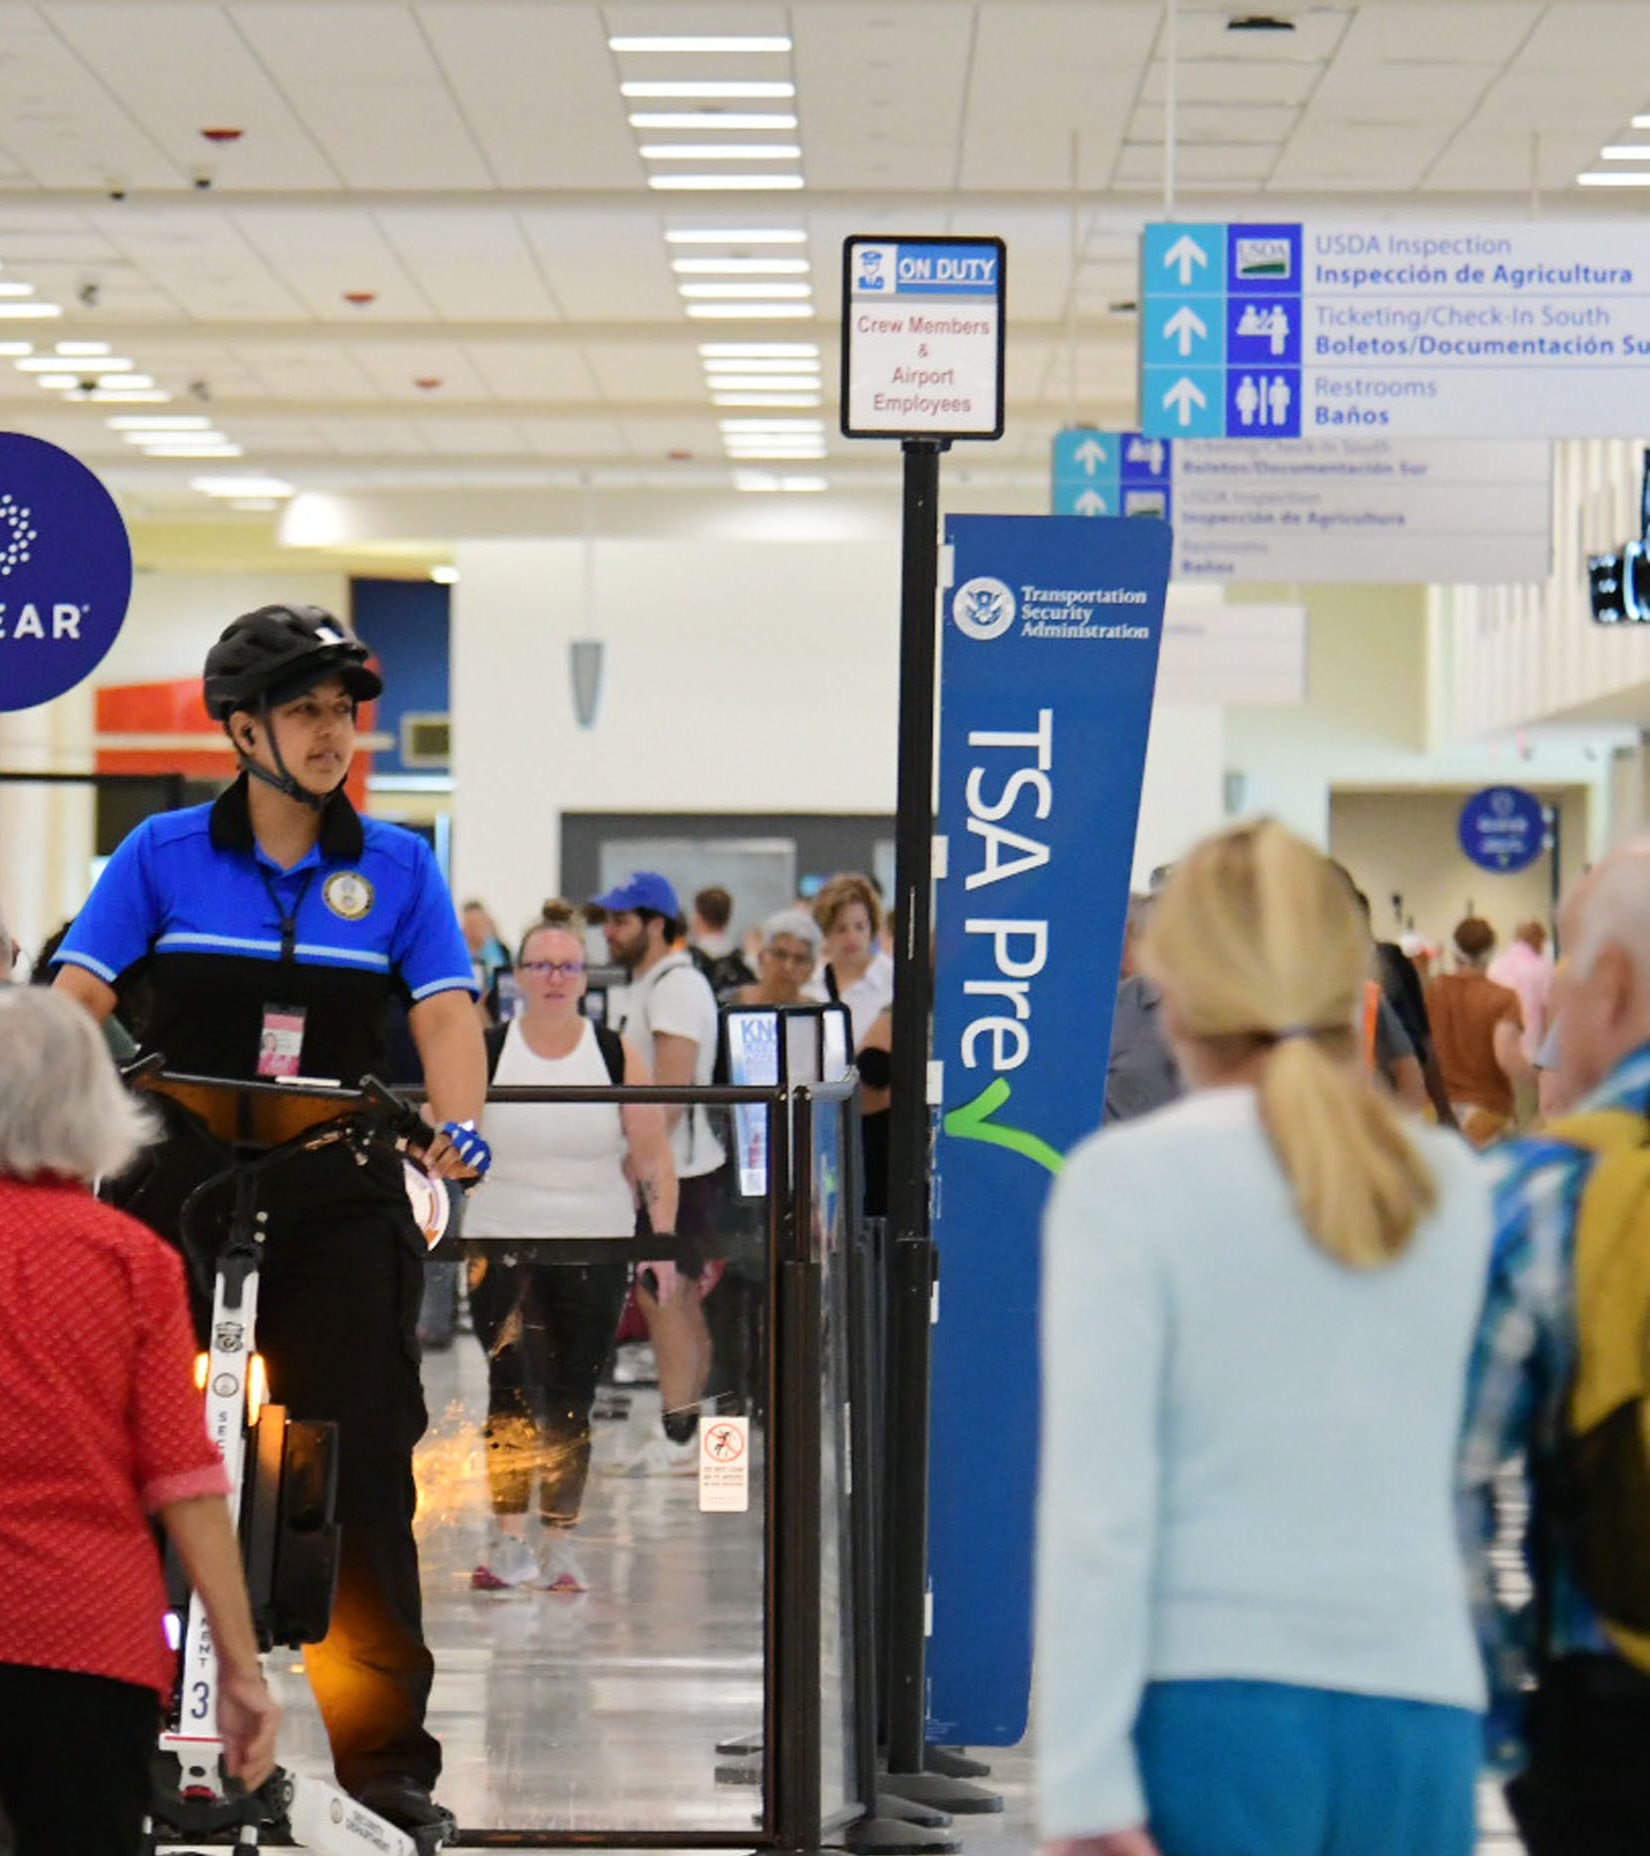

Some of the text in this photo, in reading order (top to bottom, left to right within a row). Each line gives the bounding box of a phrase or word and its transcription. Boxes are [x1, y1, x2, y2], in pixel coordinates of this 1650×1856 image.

[1314, 234, 1512, 258] USDA Inspection
[899, 258, 995, 280] ON DUTY
[1315, 264, 1634, 289] Inspección de Agricultura
[857, 315, 990, 335] Crew Members
[1315, 306, 1610, 330] Ticketing/Check-In South
[918, 344, 928, 358] &
[1315, 335, 1615, 356] Boletos/Documentación
[892, 367, 955, 387] Airport
[1315, 377, 1438, 398] Restrooms
[873, 394, 972, 416] Employees
[1315, 405, 1390, 425] Baños
[1020, 586, 1148, 606] Transportation
[1021, 603, 1094, 624] Security
[1020, 622, 1149, 640] Administration
[960, 708, 1053, 1072] TSA Pre
[741, 1018, 778, 1043] KN
[190, 1681, 210, 1719] 3
